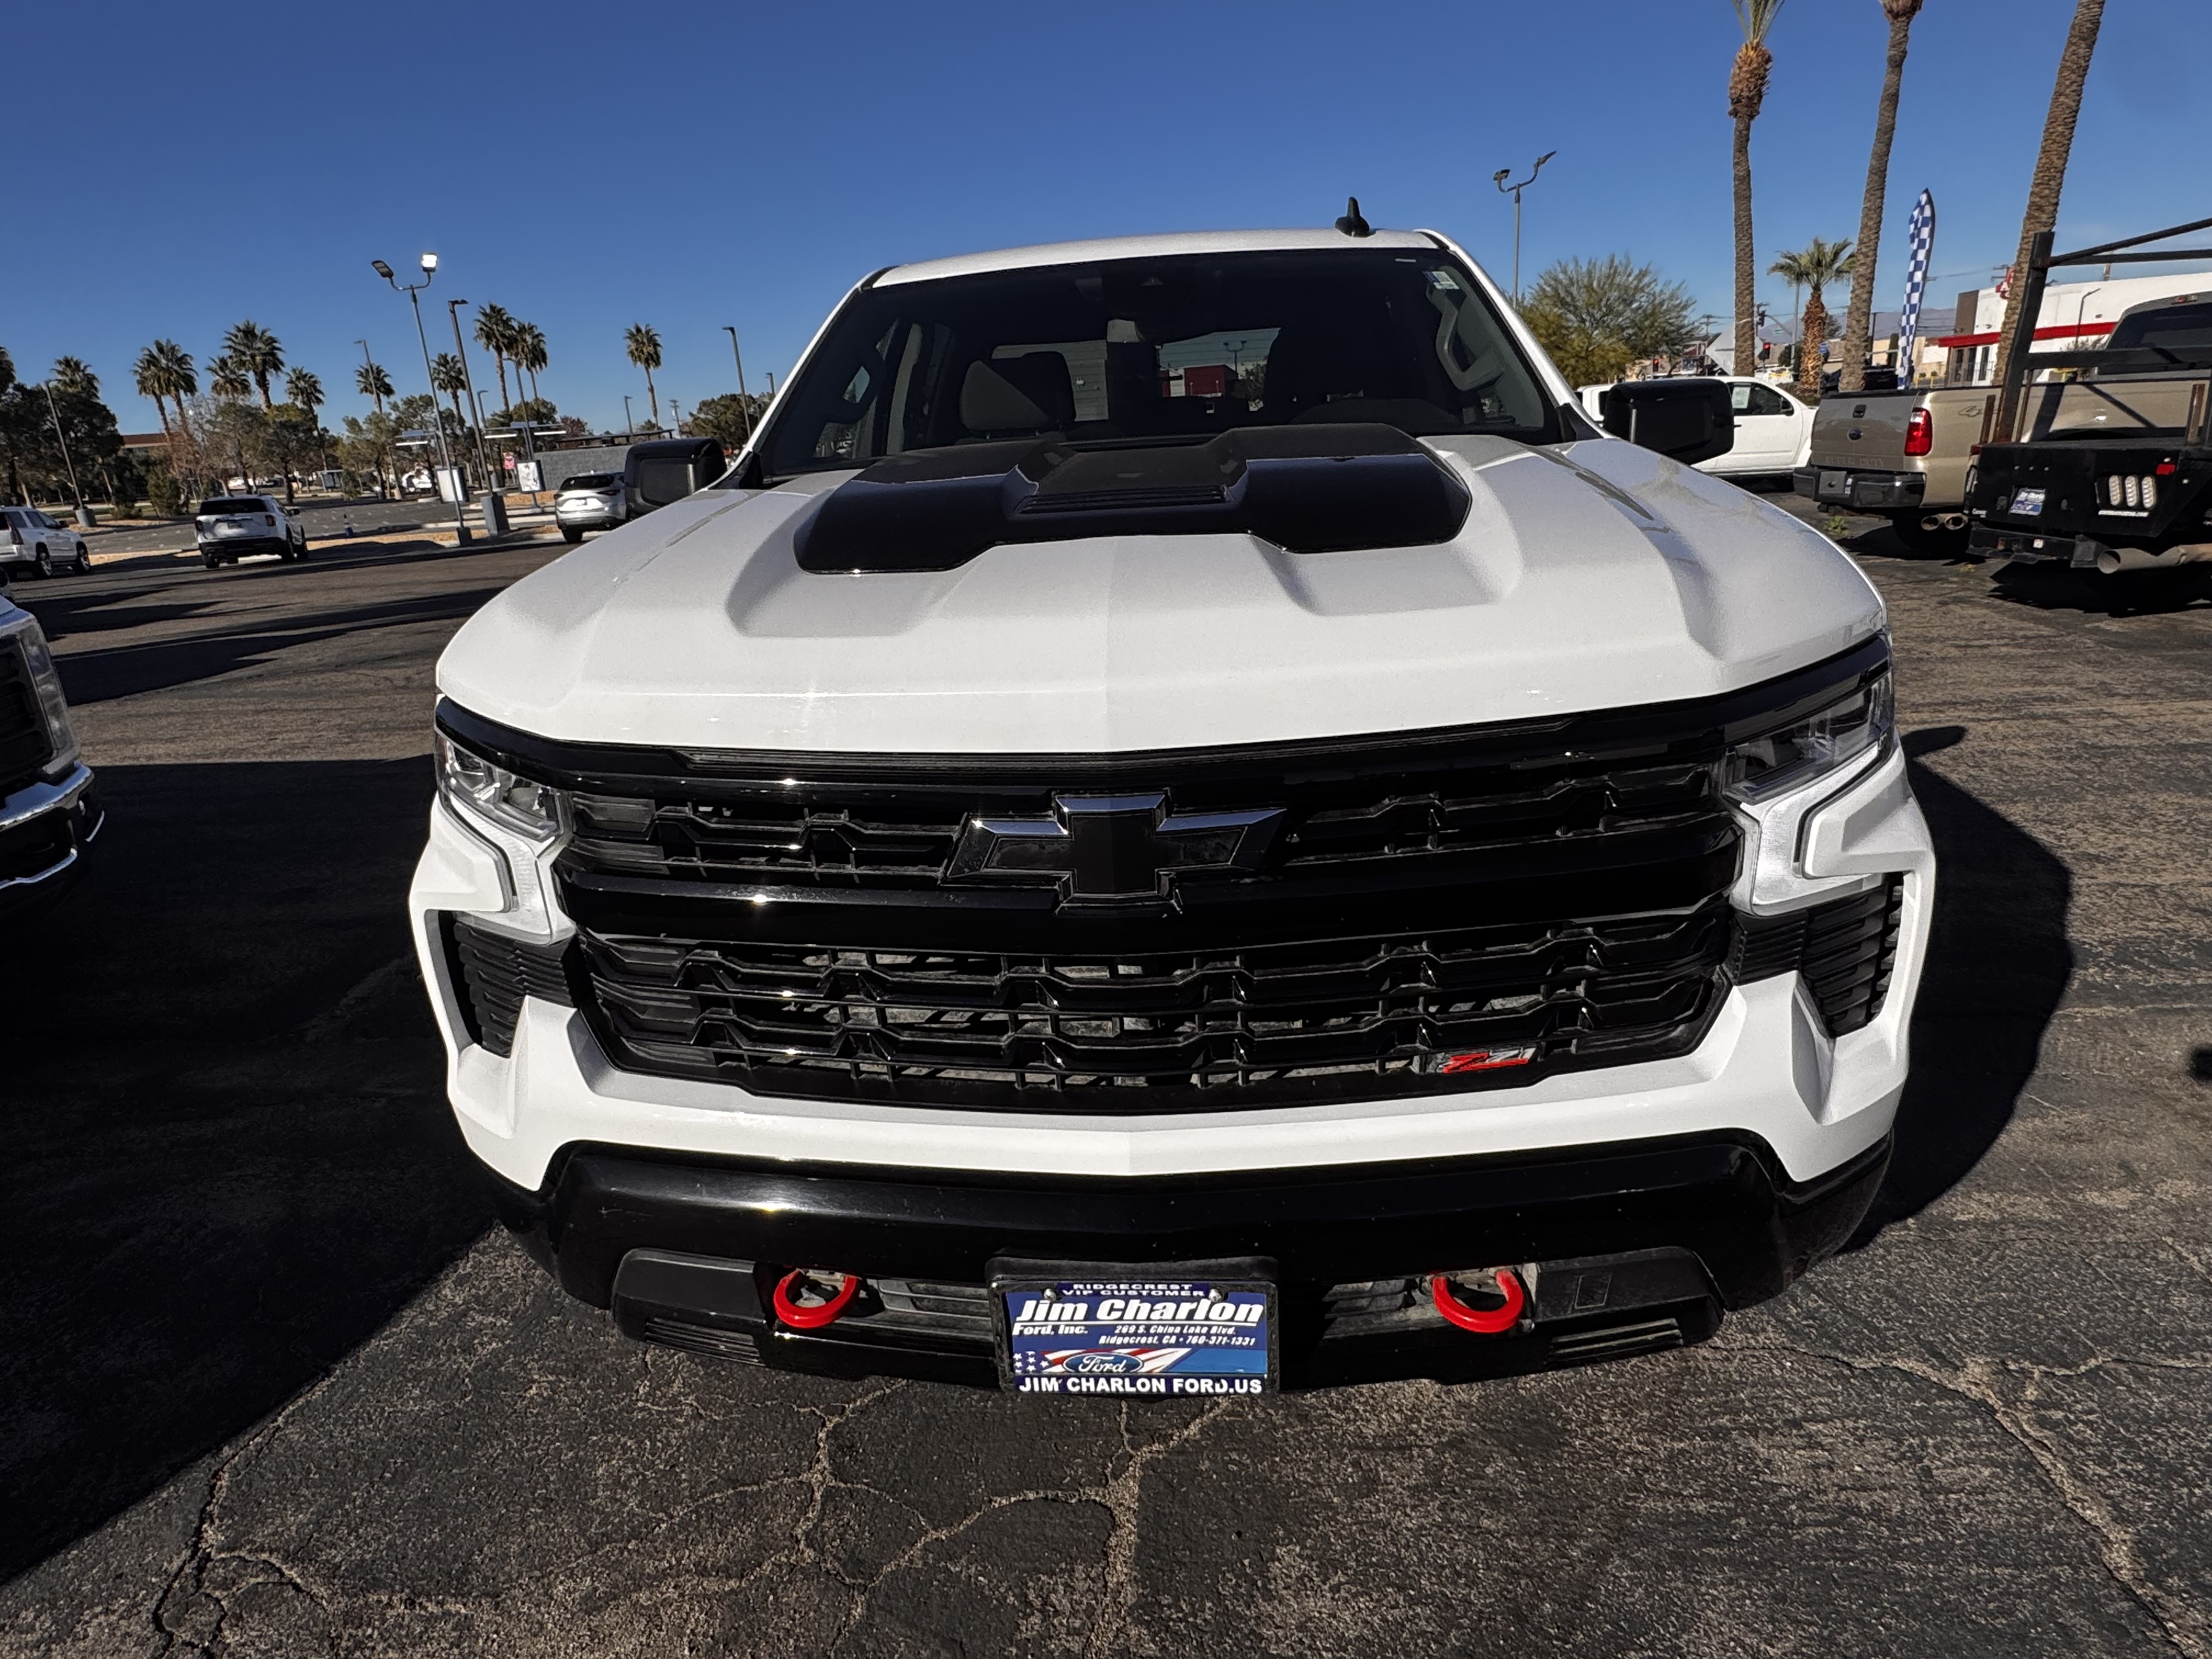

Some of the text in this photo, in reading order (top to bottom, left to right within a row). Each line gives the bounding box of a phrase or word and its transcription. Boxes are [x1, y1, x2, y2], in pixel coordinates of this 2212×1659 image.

[1015, 1298, 1264, 1323] Jim Charlon
[1058, 1324, 1088, 1334] Inc.
[1149, 1325, 1181, 1334] China
[1182, 1325, 1208, 1334] Lake
[1162, 1335, 1177, 1344] CA
[1078, 1355, 1127, 1372] Ford
[1019, 1377, 1262, 1393] JIM CHARLON FORD.US
